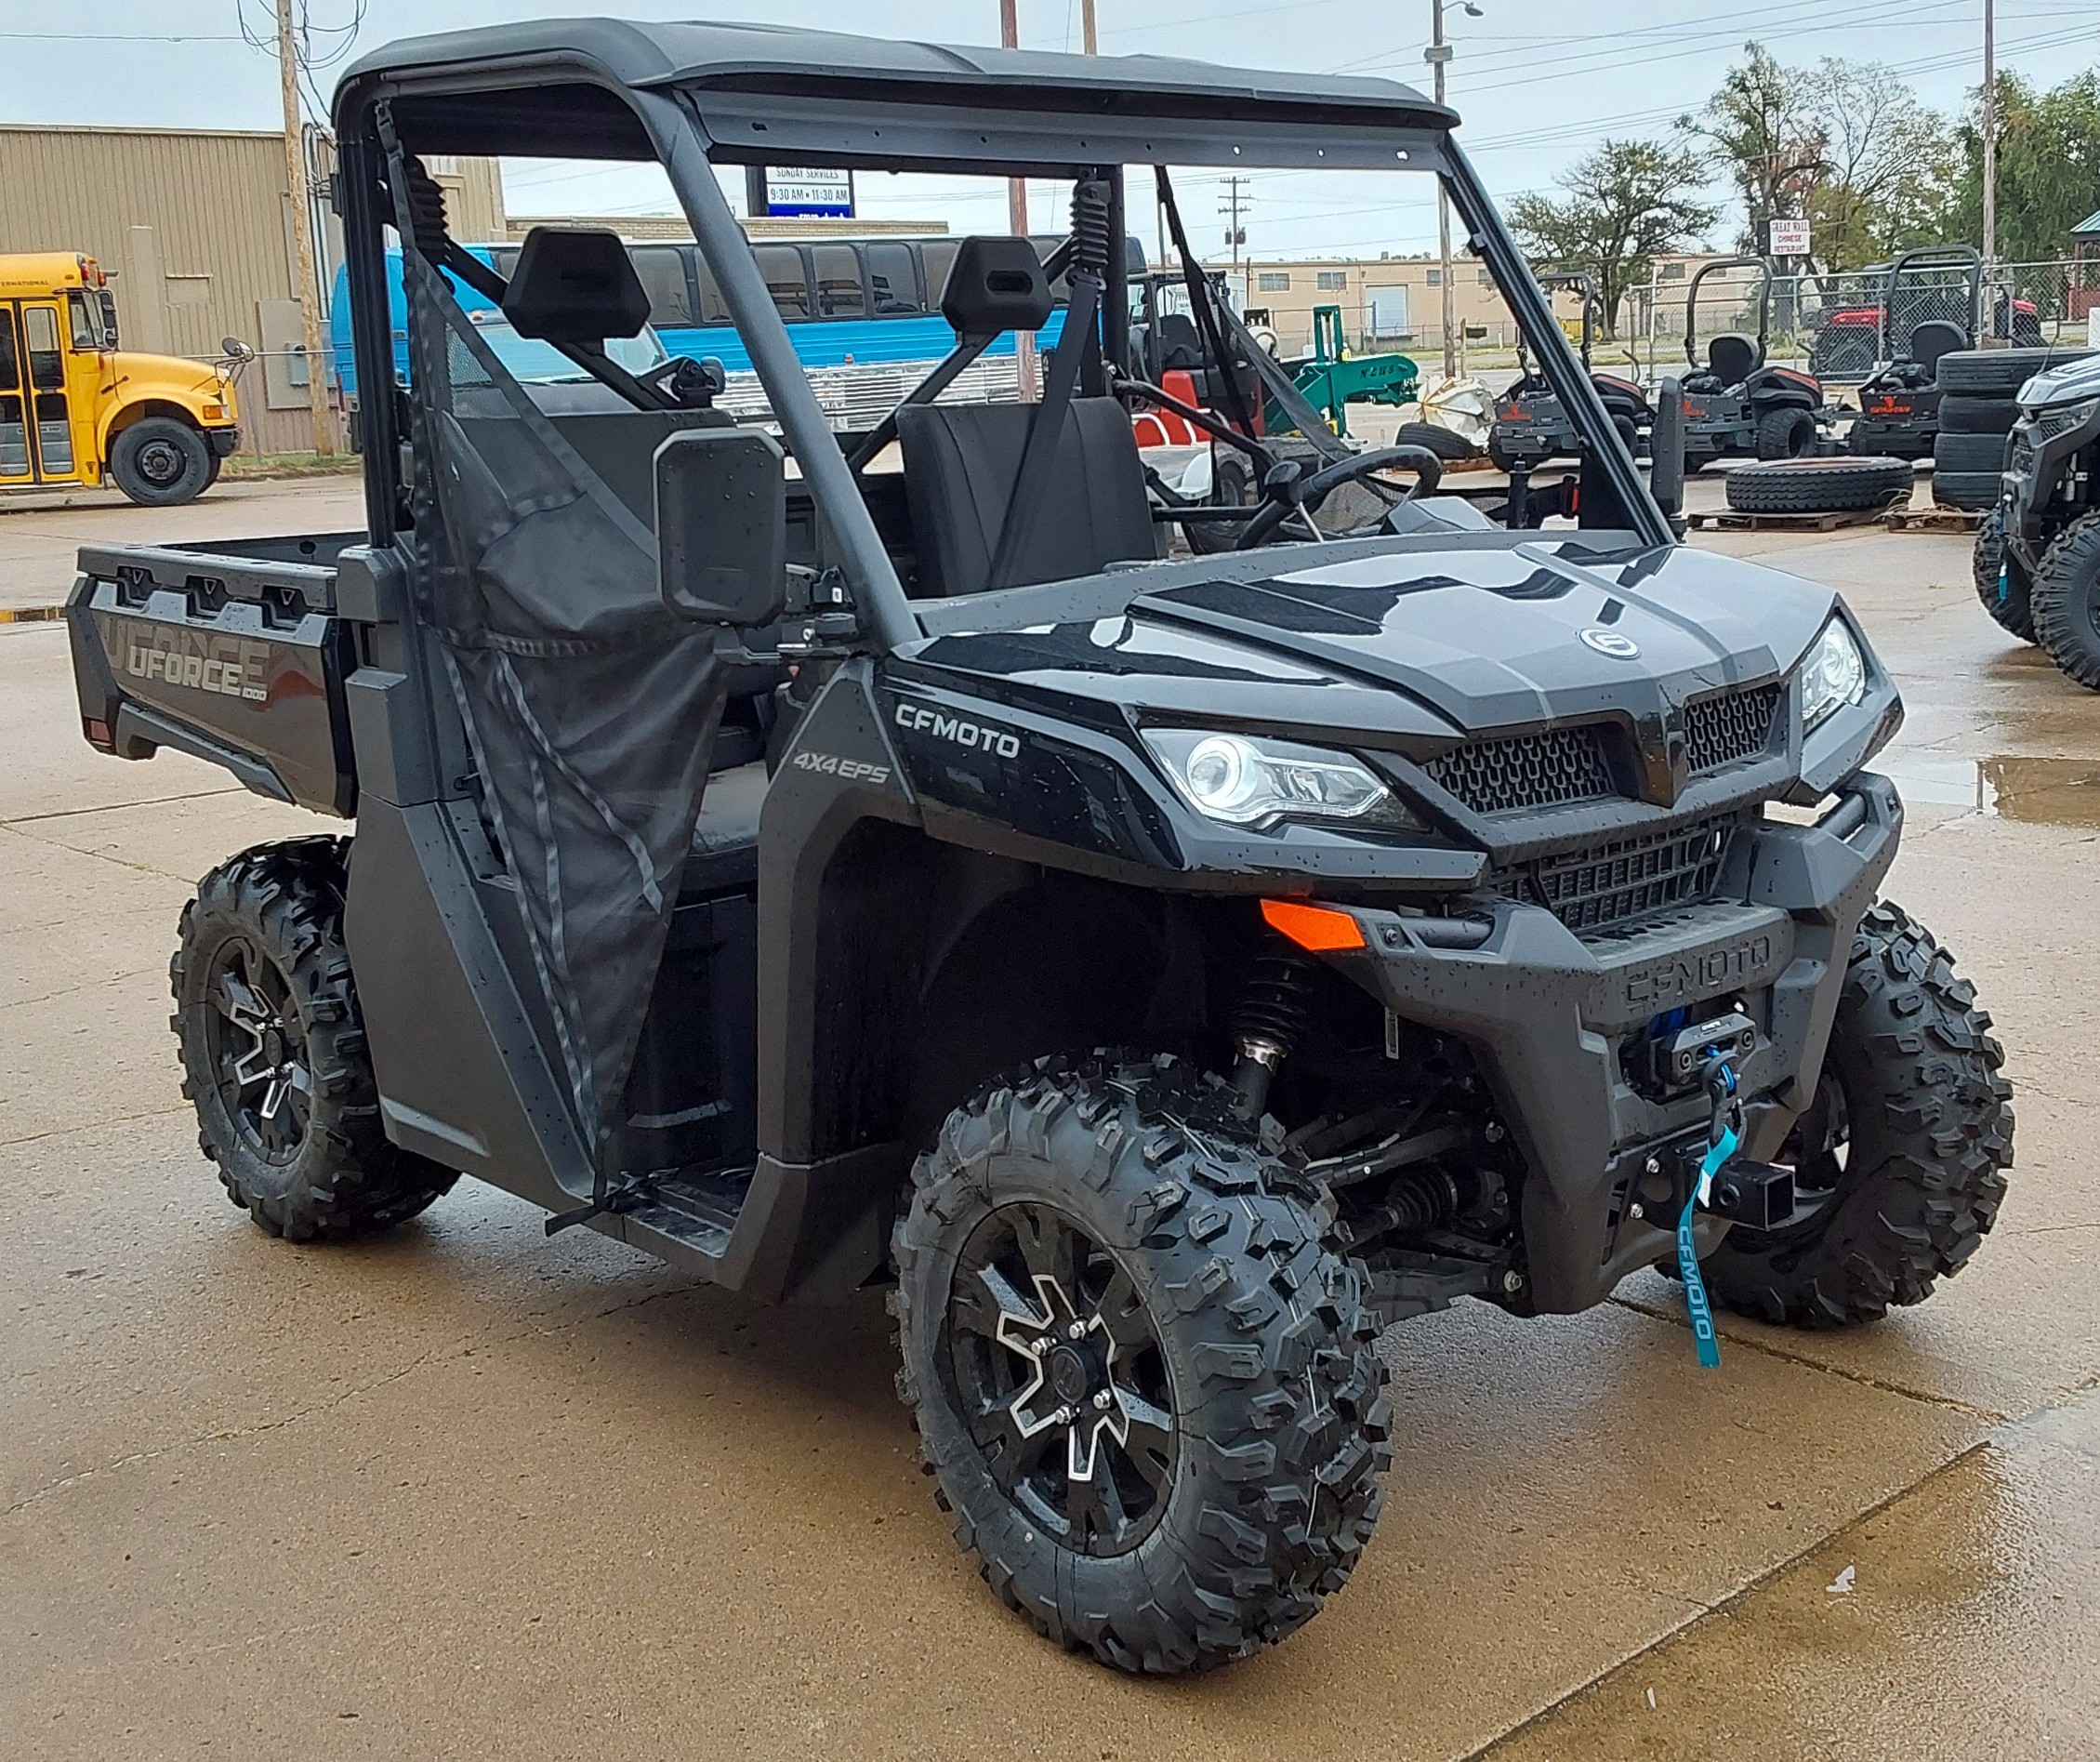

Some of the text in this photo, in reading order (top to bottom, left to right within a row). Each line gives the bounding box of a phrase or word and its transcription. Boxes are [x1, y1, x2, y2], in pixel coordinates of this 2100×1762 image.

[771, 189, 848, 201] 9:30 AM 11:30 AM
[128, 645, 244, 696] UFORCE
[895, 703, 1020, 759] CFMOTO
[1627, 935, 1770, 1007] CFMOTO
[1679, 1225, 1711, 1340] CFMOTO
